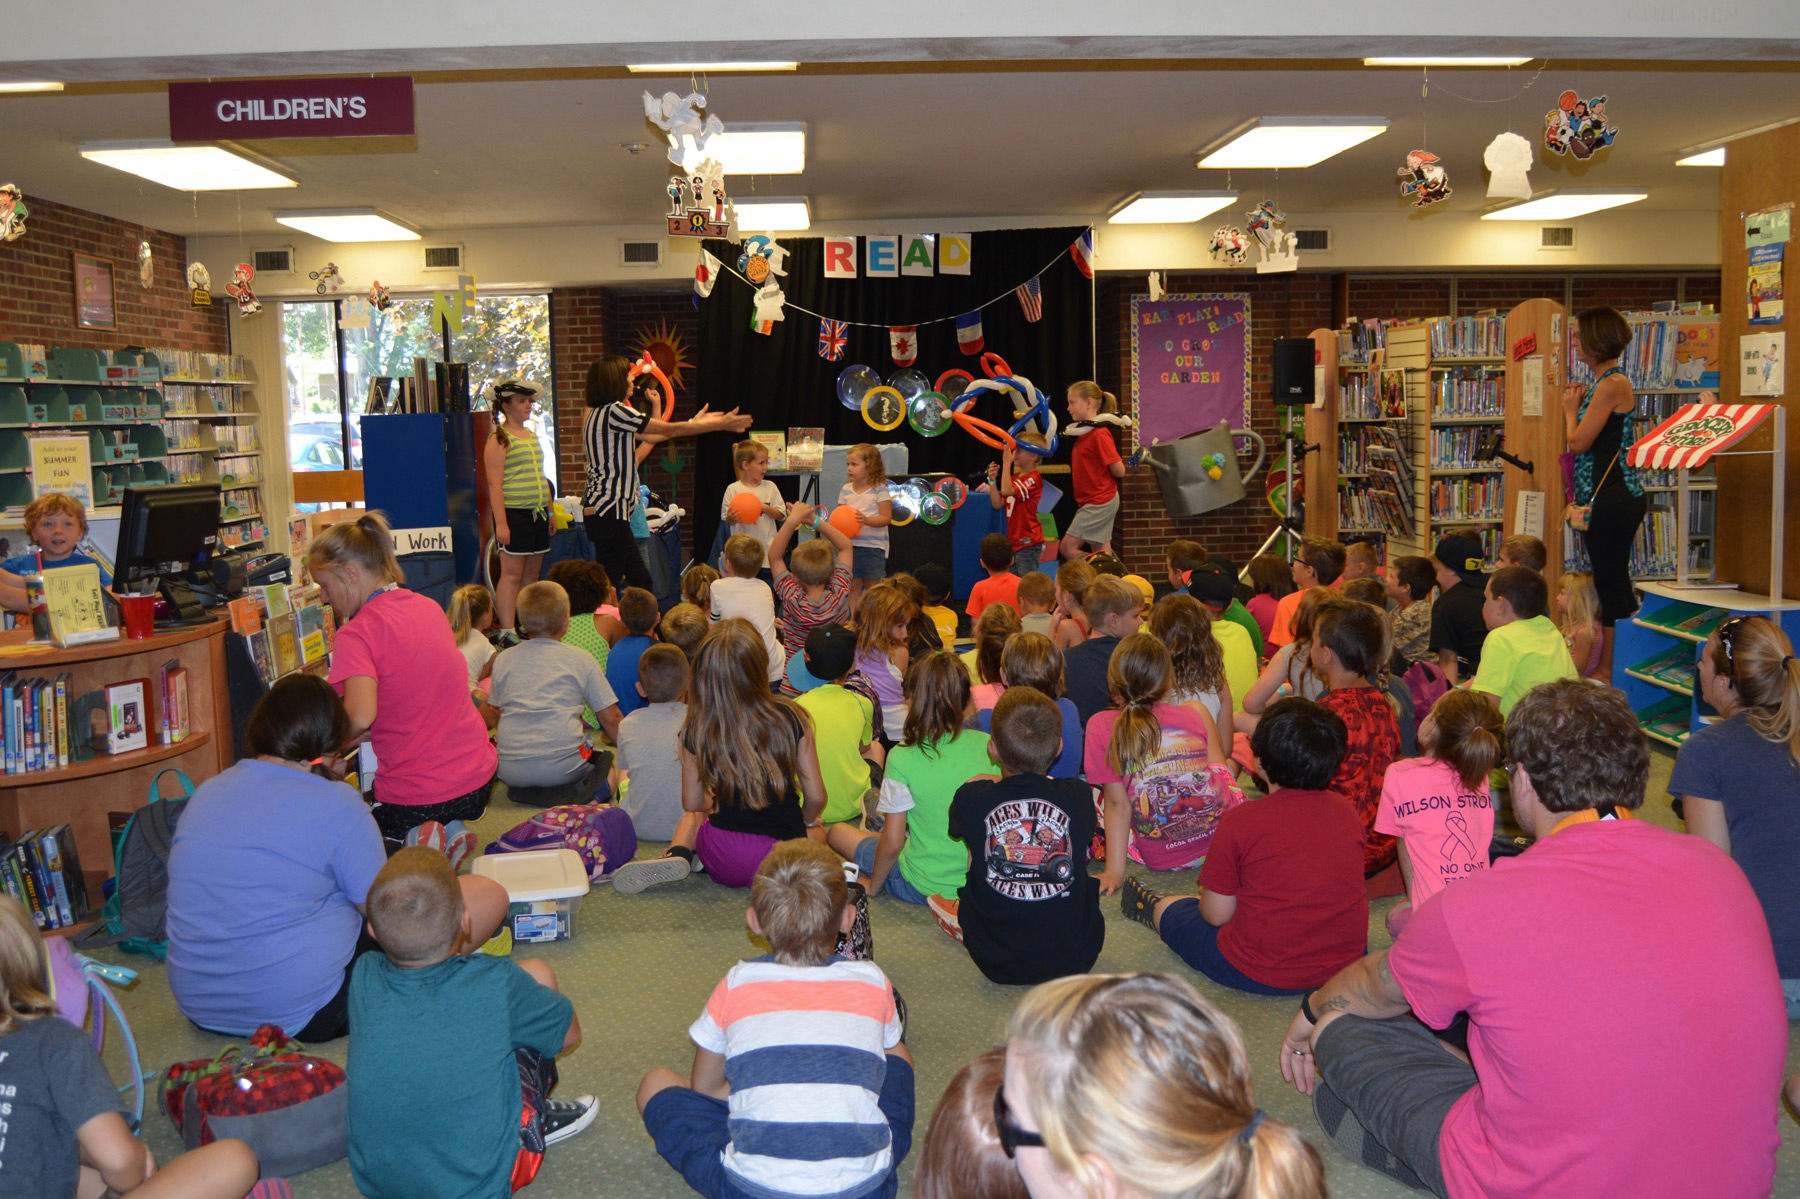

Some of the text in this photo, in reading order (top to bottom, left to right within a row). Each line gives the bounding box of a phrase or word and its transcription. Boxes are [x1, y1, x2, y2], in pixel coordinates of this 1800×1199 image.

[217, 96, 366, 123] CHILDREN'S
[825, 237, 970, 272] READ
[1156, 340, 1173, 352] TO
[1176, 355, 1204, 367] OUR
[1161, 372, 1221, 384] GARDEN
[1667, 417, 1733, 437] GROCERY
[1663, 435, 1712, 446] STORE
[43, 456, 77, 464] SUMMER
[408, 532, 447, 550] Work
[1393, 796, 1451, 819] WILSON
[989, 803, 1022, 832] ACES
[1028, 802, 1068, 826] WILD
[1165, 840, 1187, 850] COCOA
[17, 846, 26, 862] GREEN
[1440, 863, 1458, 874] NO
[24, 874, 36, 897] PERFECT
[989, 877, 1026, 898] ACES
